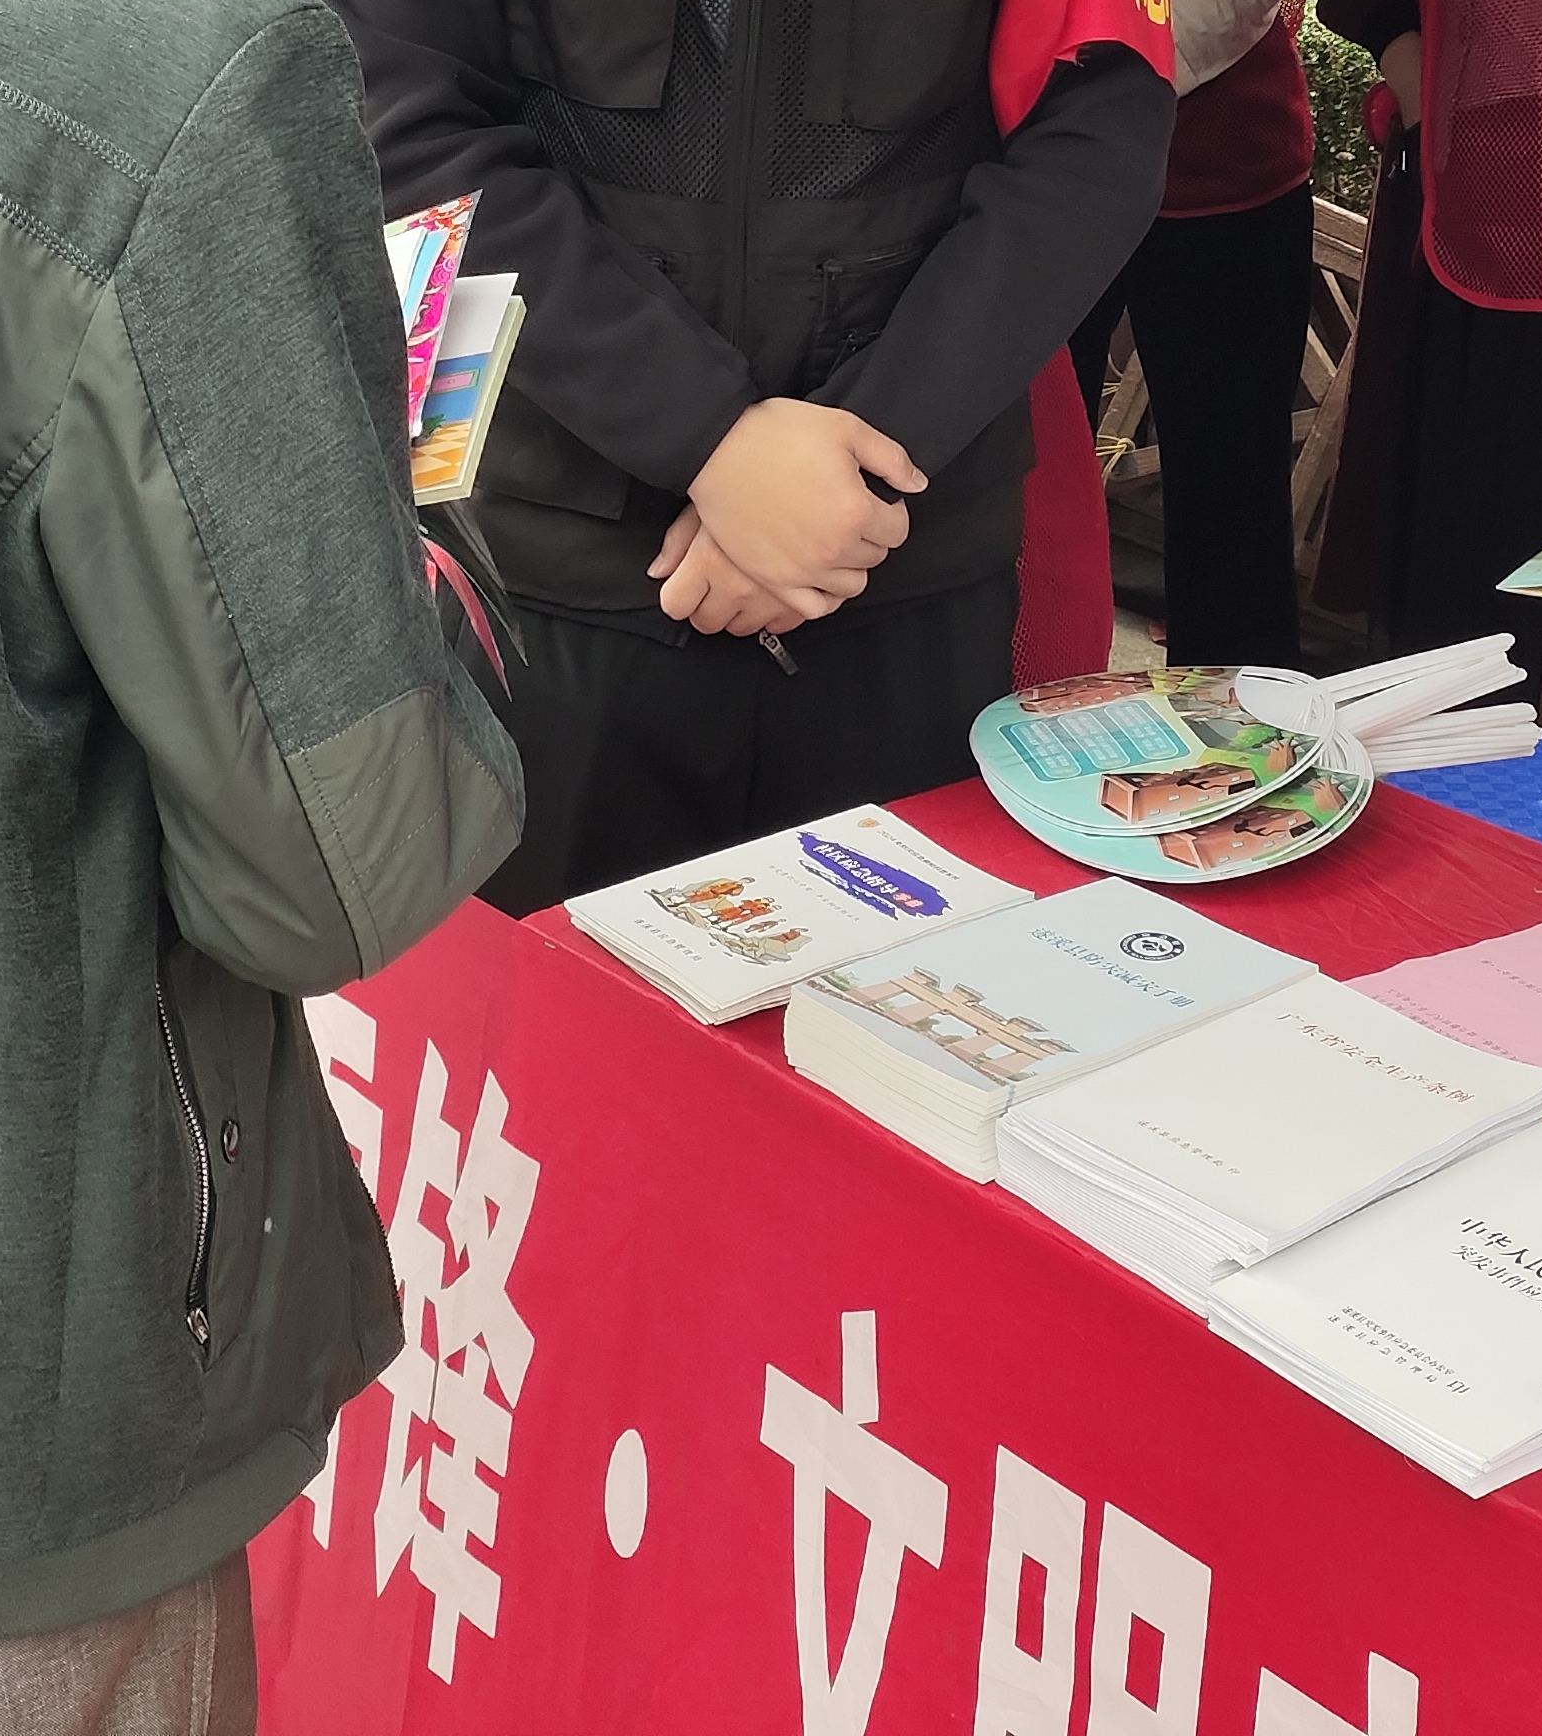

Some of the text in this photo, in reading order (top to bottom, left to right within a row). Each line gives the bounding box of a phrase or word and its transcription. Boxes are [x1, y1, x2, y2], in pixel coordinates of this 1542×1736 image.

[1029, 925, 1196, 1008] 遂溪县防灾减灾手册
[1275, 1011, 1476, 1105] 广东省安全生产条例
[304, 994, 1440, 1736] 锋·文明
[1446, 1379, 1471, 1394] 印
